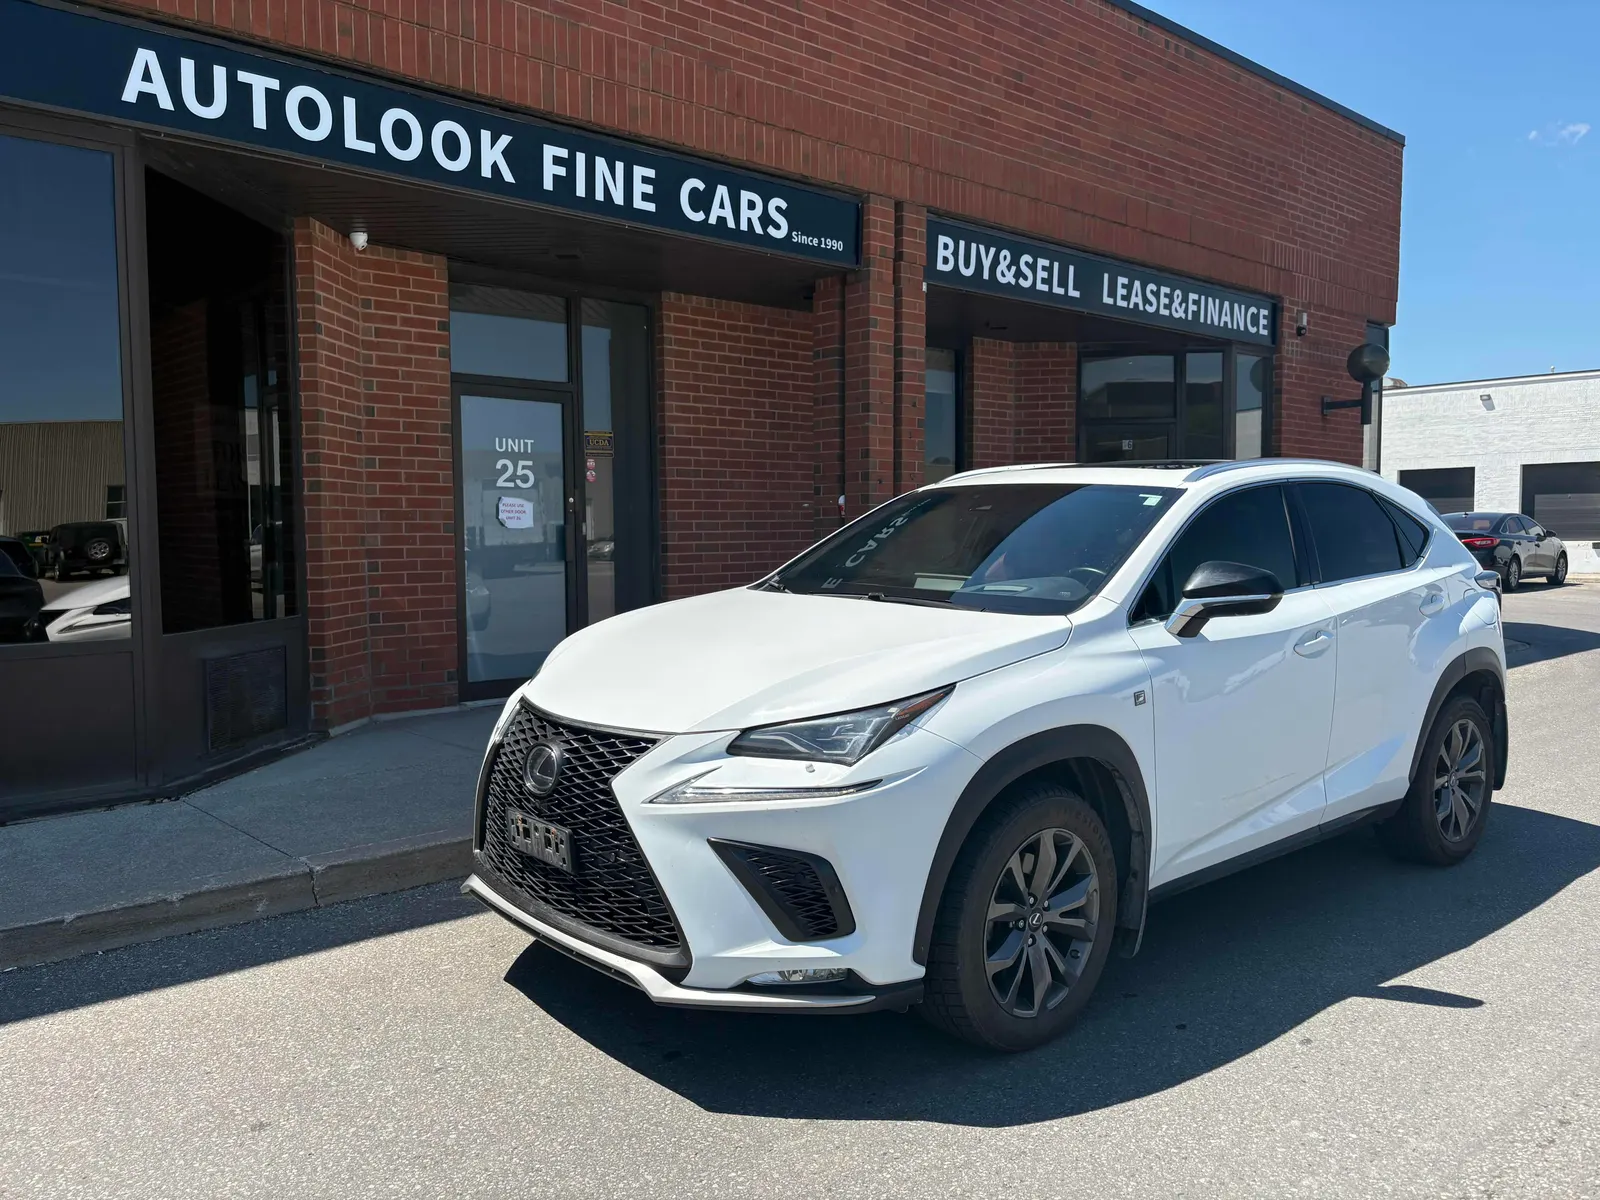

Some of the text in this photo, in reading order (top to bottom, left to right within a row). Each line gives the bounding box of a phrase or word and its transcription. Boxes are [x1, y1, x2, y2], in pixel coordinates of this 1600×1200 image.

[121, 48, 789, 239] AUTOLOOK FINE CARS
[791, 231, 844, 251] Since 1990
[936, 235, 1269, 336] BUY&SELL LEASE&FINANCE
[495, 437, 534, 453] UNIT
[496, 459, 535, 488] 25
